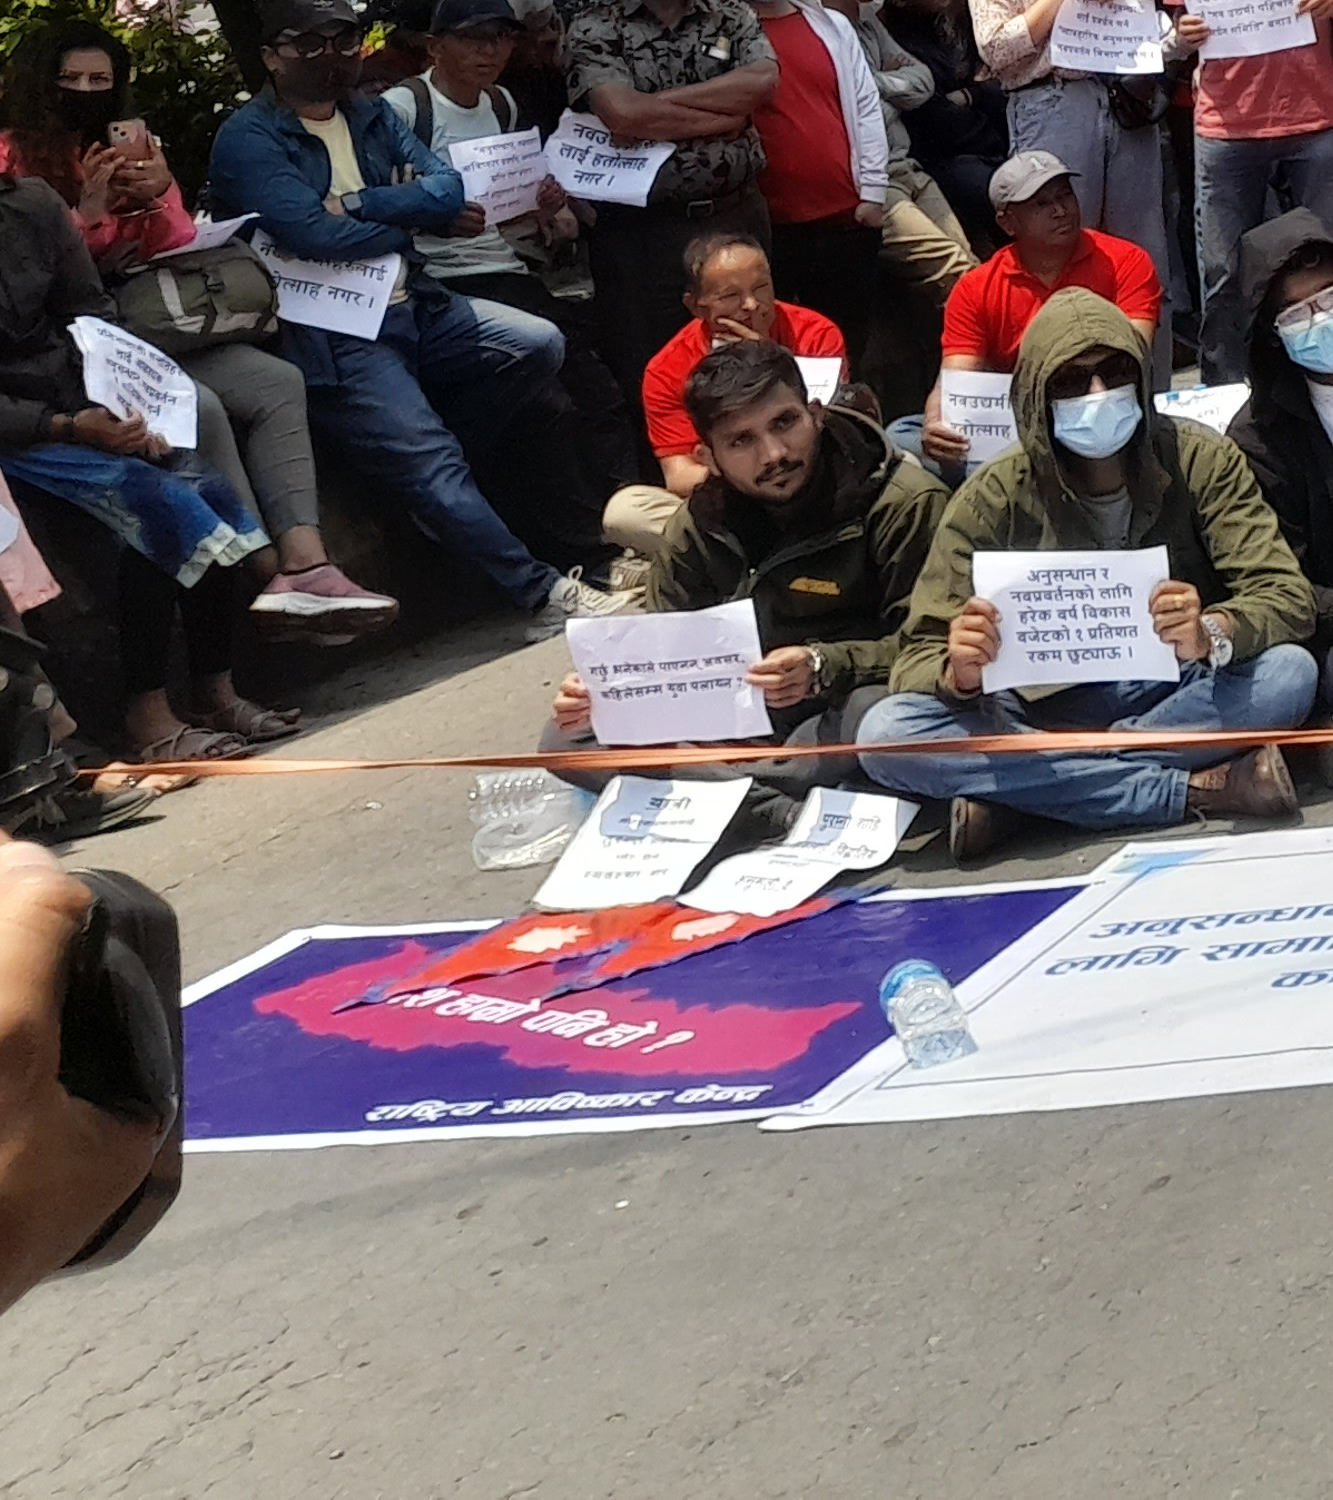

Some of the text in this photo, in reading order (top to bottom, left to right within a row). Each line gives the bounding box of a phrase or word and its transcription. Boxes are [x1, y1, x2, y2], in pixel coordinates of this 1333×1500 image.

[327, 285, 365, 306] नगर
[1027, 567, 1110, 586] अनुसन्धान र
[1010, 582, 1134, 604] नवप्रवर्तनको लागि
[1017, 606, 1052, 625] हरेक
[1082, 604, 1131, 620] विकास
[1075, 628, 1084, 642] १
[1087, 623, 1139, 641] प्रतिशत
[1026, 650, 1063, 664] रकम
[1045, 945, 1190, 978] लागि
[582, 1020, 662, 1050] हो
